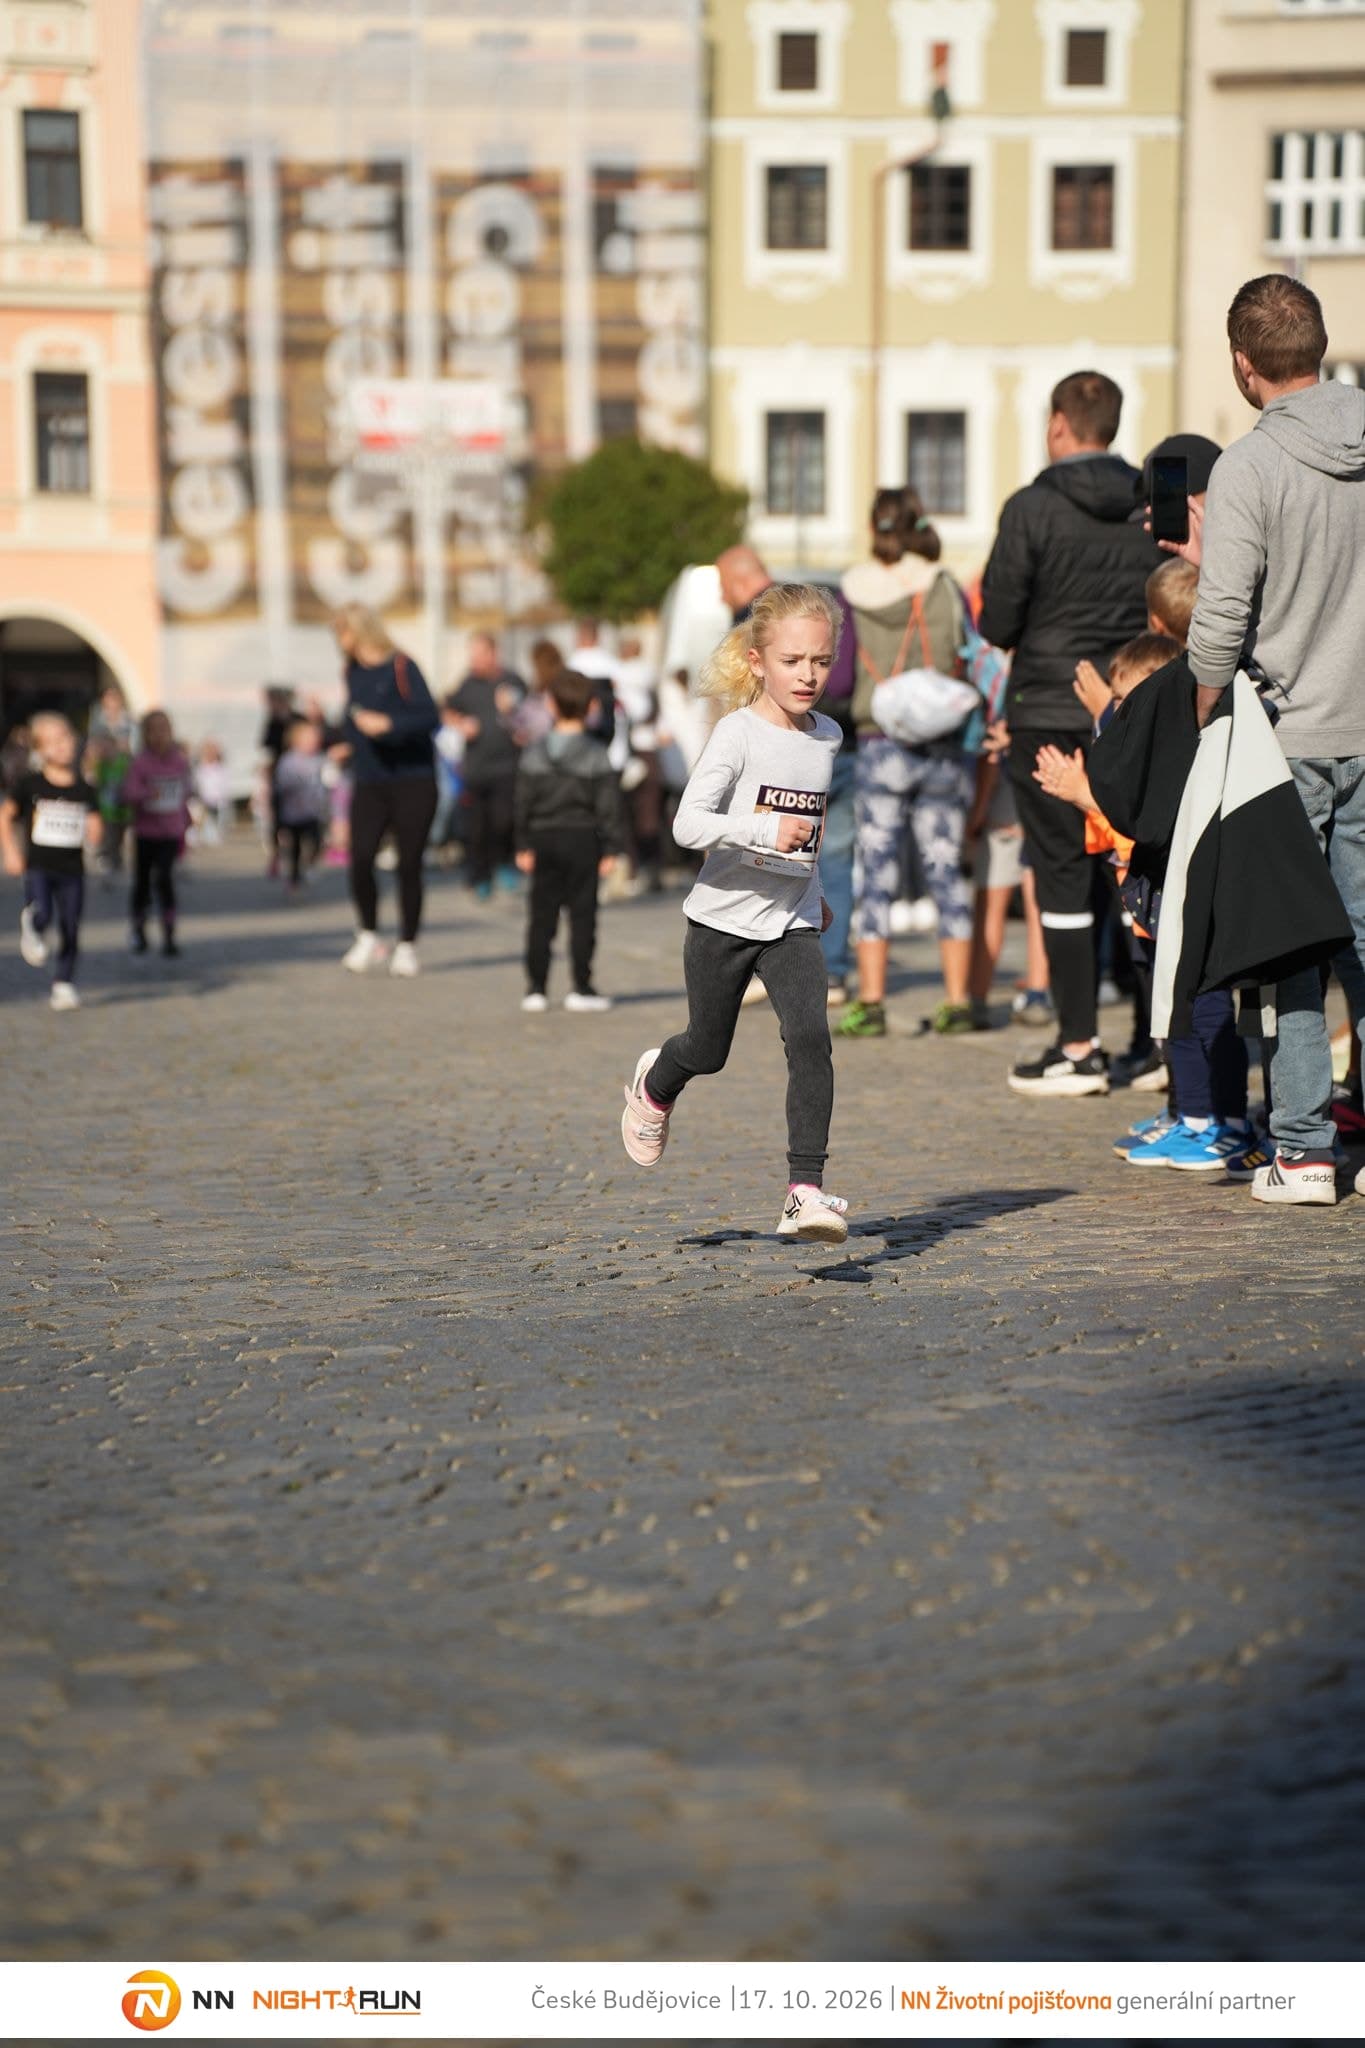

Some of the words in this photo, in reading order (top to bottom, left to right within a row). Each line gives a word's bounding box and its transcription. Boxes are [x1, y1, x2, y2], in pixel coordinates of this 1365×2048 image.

[150, 175, 245, 613] Ceresit
[763, 788, 824, 810] KIDSCU
[1301, 1173, 1333, 1183] adida
